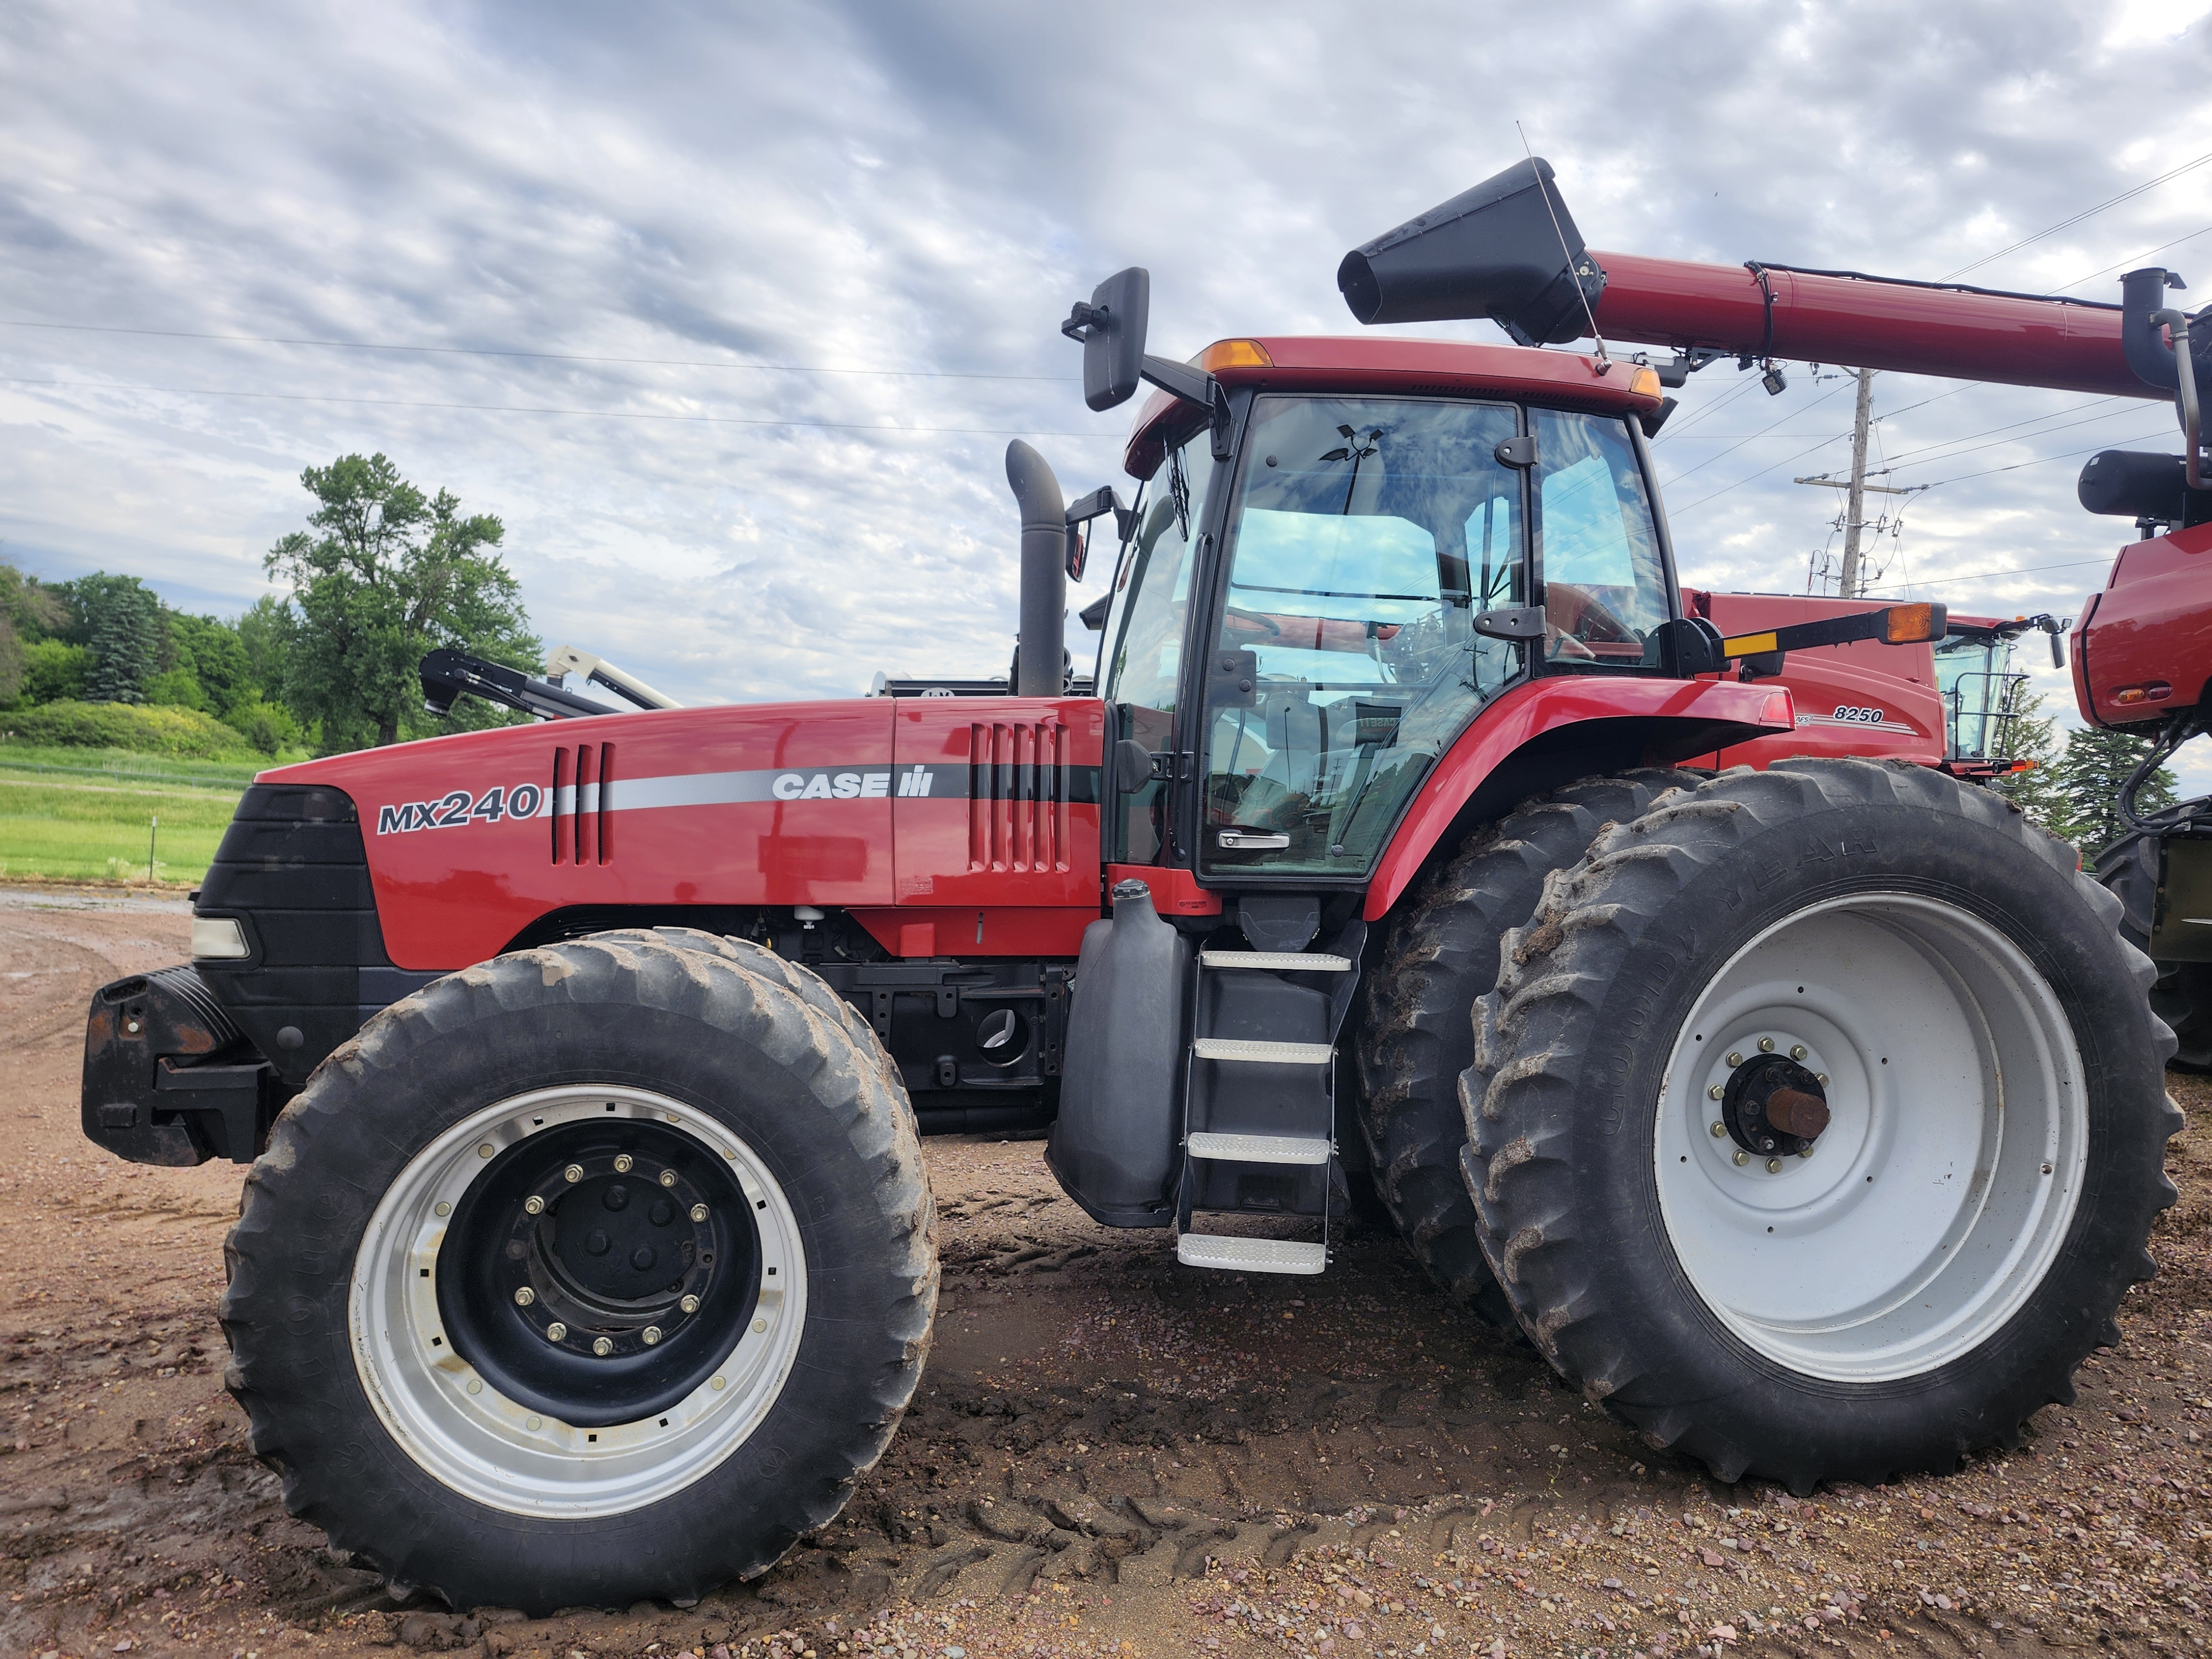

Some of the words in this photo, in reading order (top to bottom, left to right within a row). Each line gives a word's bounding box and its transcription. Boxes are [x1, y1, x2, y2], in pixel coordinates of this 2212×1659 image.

[1834, 706, 1883, 723] 8250
[773, 773, 890, 800] CASE
[378, 784, 540, 834] MX240
